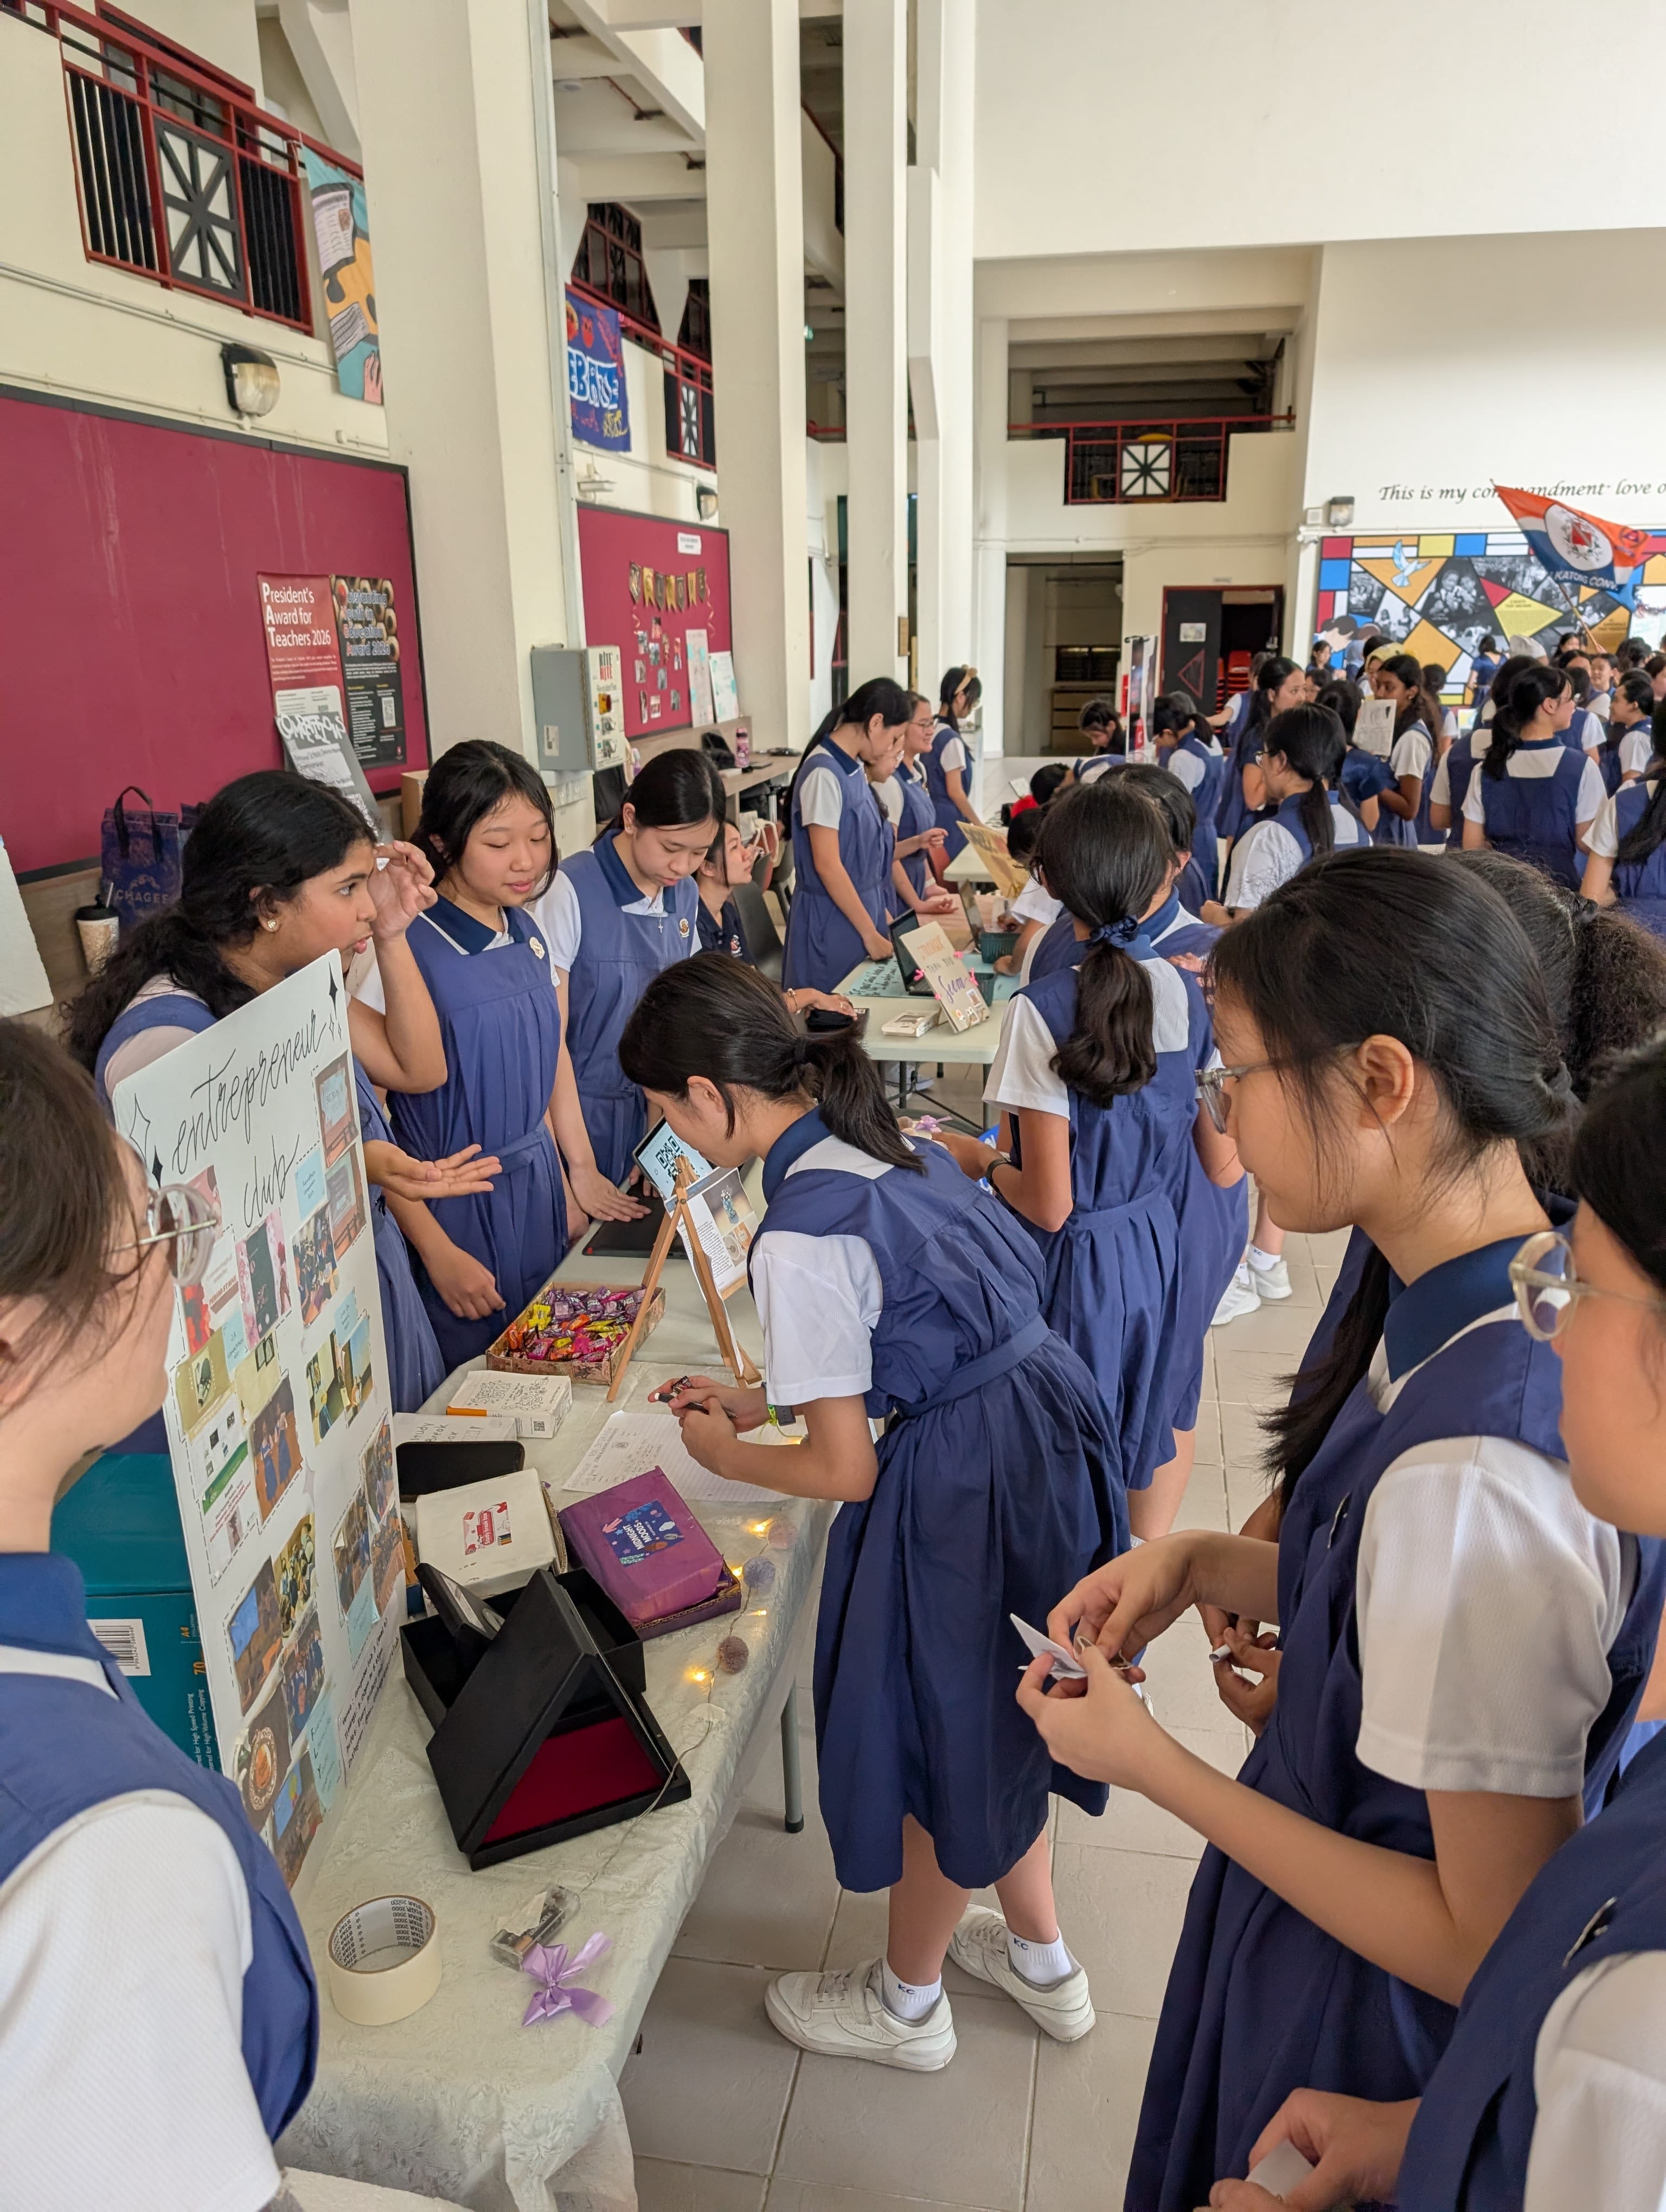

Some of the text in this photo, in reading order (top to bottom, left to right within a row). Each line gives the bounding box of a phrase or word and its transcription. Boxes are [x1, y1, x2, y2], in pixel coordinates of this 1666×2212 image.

[1379, 485, 1416, 501] This
[1419, 487, 1433, 500] is
[1439, 488, 1466, 505] my
[1616, 479, 1651, 496] love
[262, 582, 315, 603] President's
[266, 605, 312, 625] Award for
[267, 627, 331, 647] Teachers 2026
[346, 641, 371, 657] Award
[115, 889, 169, 904] CHAGEE
[938, 975, 969, 1004] Seem
[171, 1008, 328, 1175] entrepreneur
[243, 1134, 300, 1227] club
[623, 1523, 645, 1551] MIDNIGHT
[633, 1521, 652, 1543] MOODS
[181, 1626, 190, 1638] A4
[201, 1711, 209, 1732] Volume
[204, 1732, 212, 1745] High
[1014, 1937, 1029, 1951] KC
[897, 1983, 915, 1996] KC
